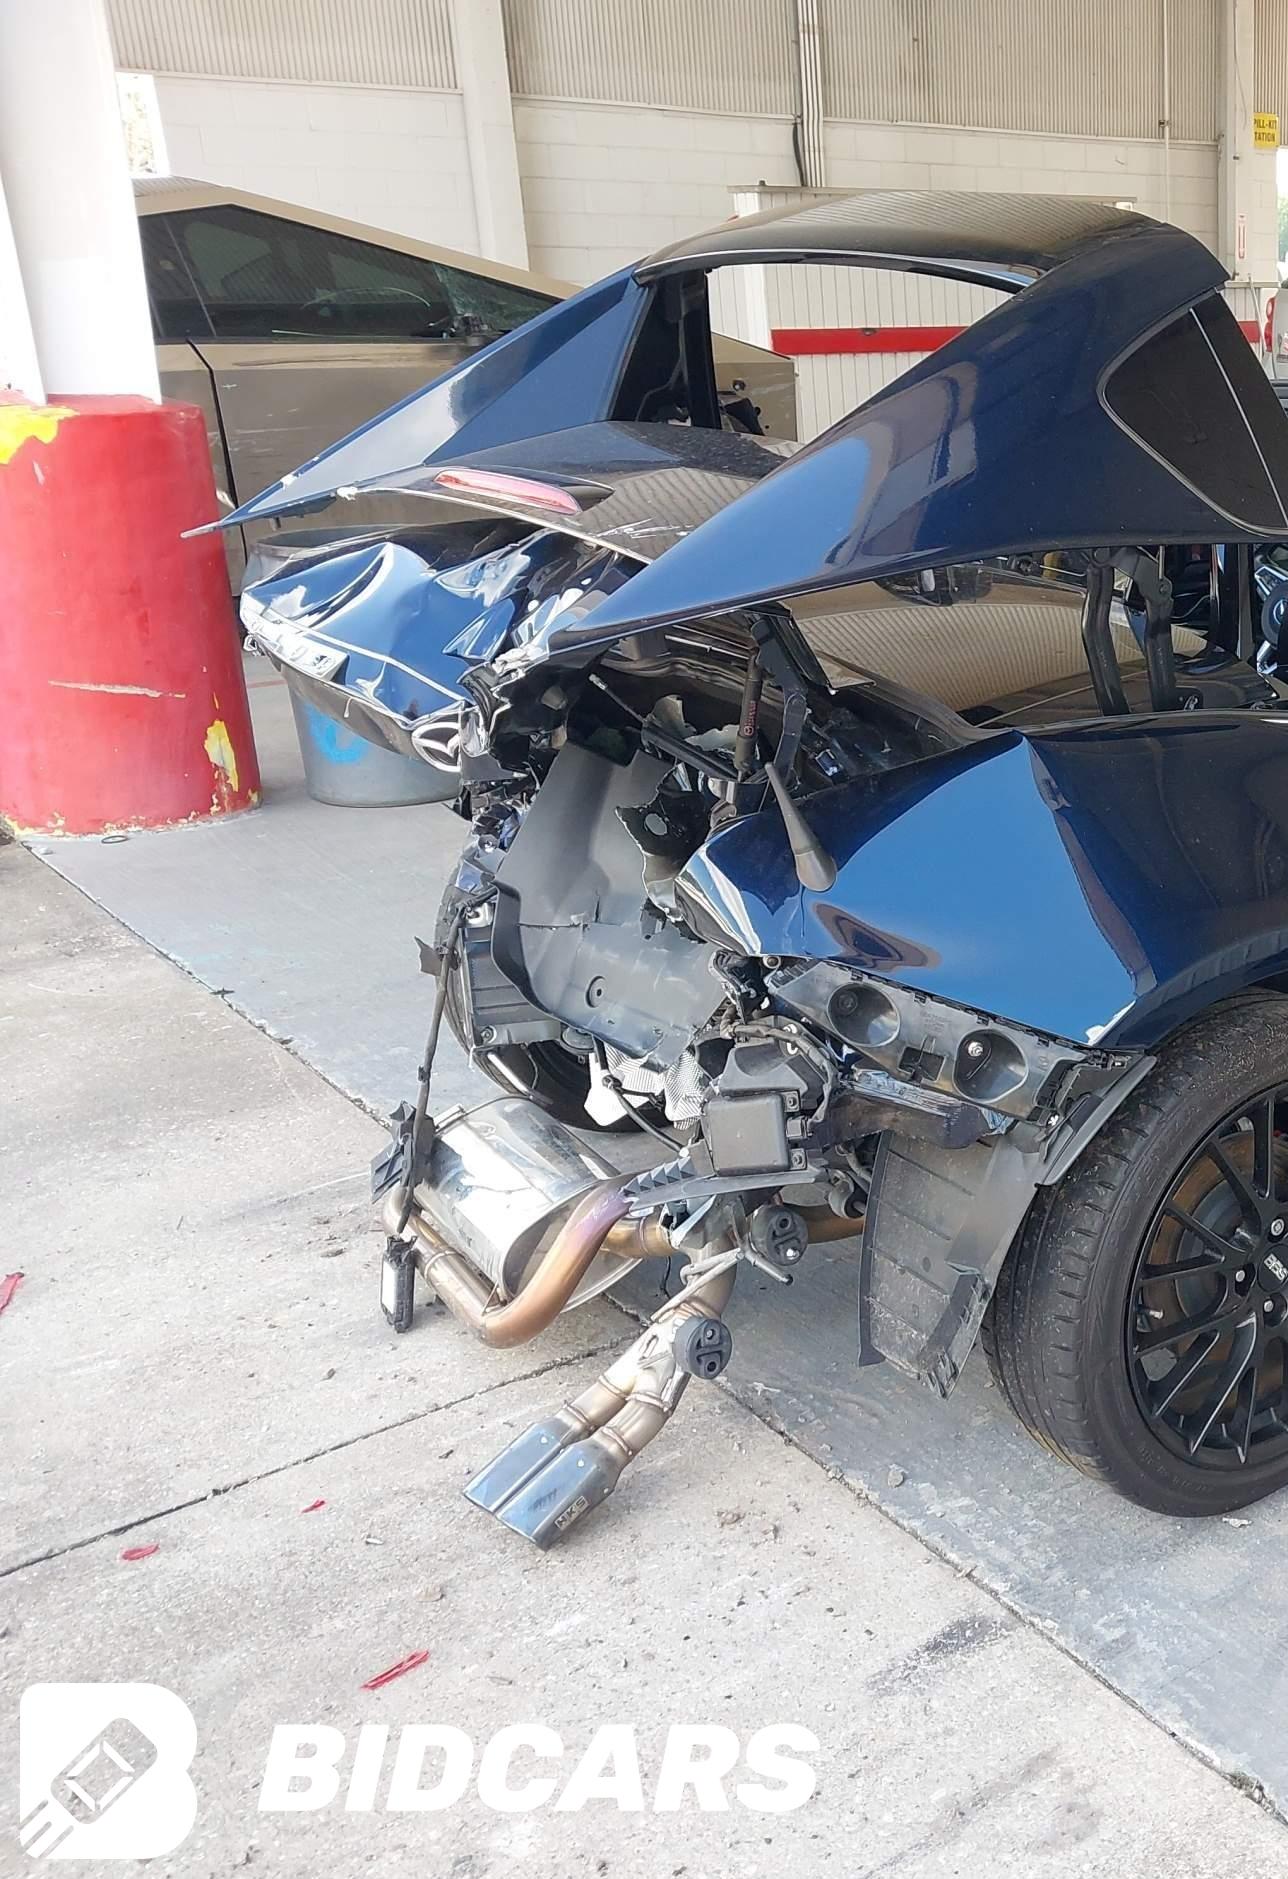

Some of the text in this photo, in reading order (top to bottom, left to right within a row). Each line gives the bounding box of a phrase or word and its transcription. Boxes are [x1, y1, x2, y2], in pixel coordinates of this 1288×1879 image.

[1253, 118, 1277, 129] PILL-KIT
[1254, 131, 1276, 142] TATION
[1263, 1253, 1288, 1281] BBS
